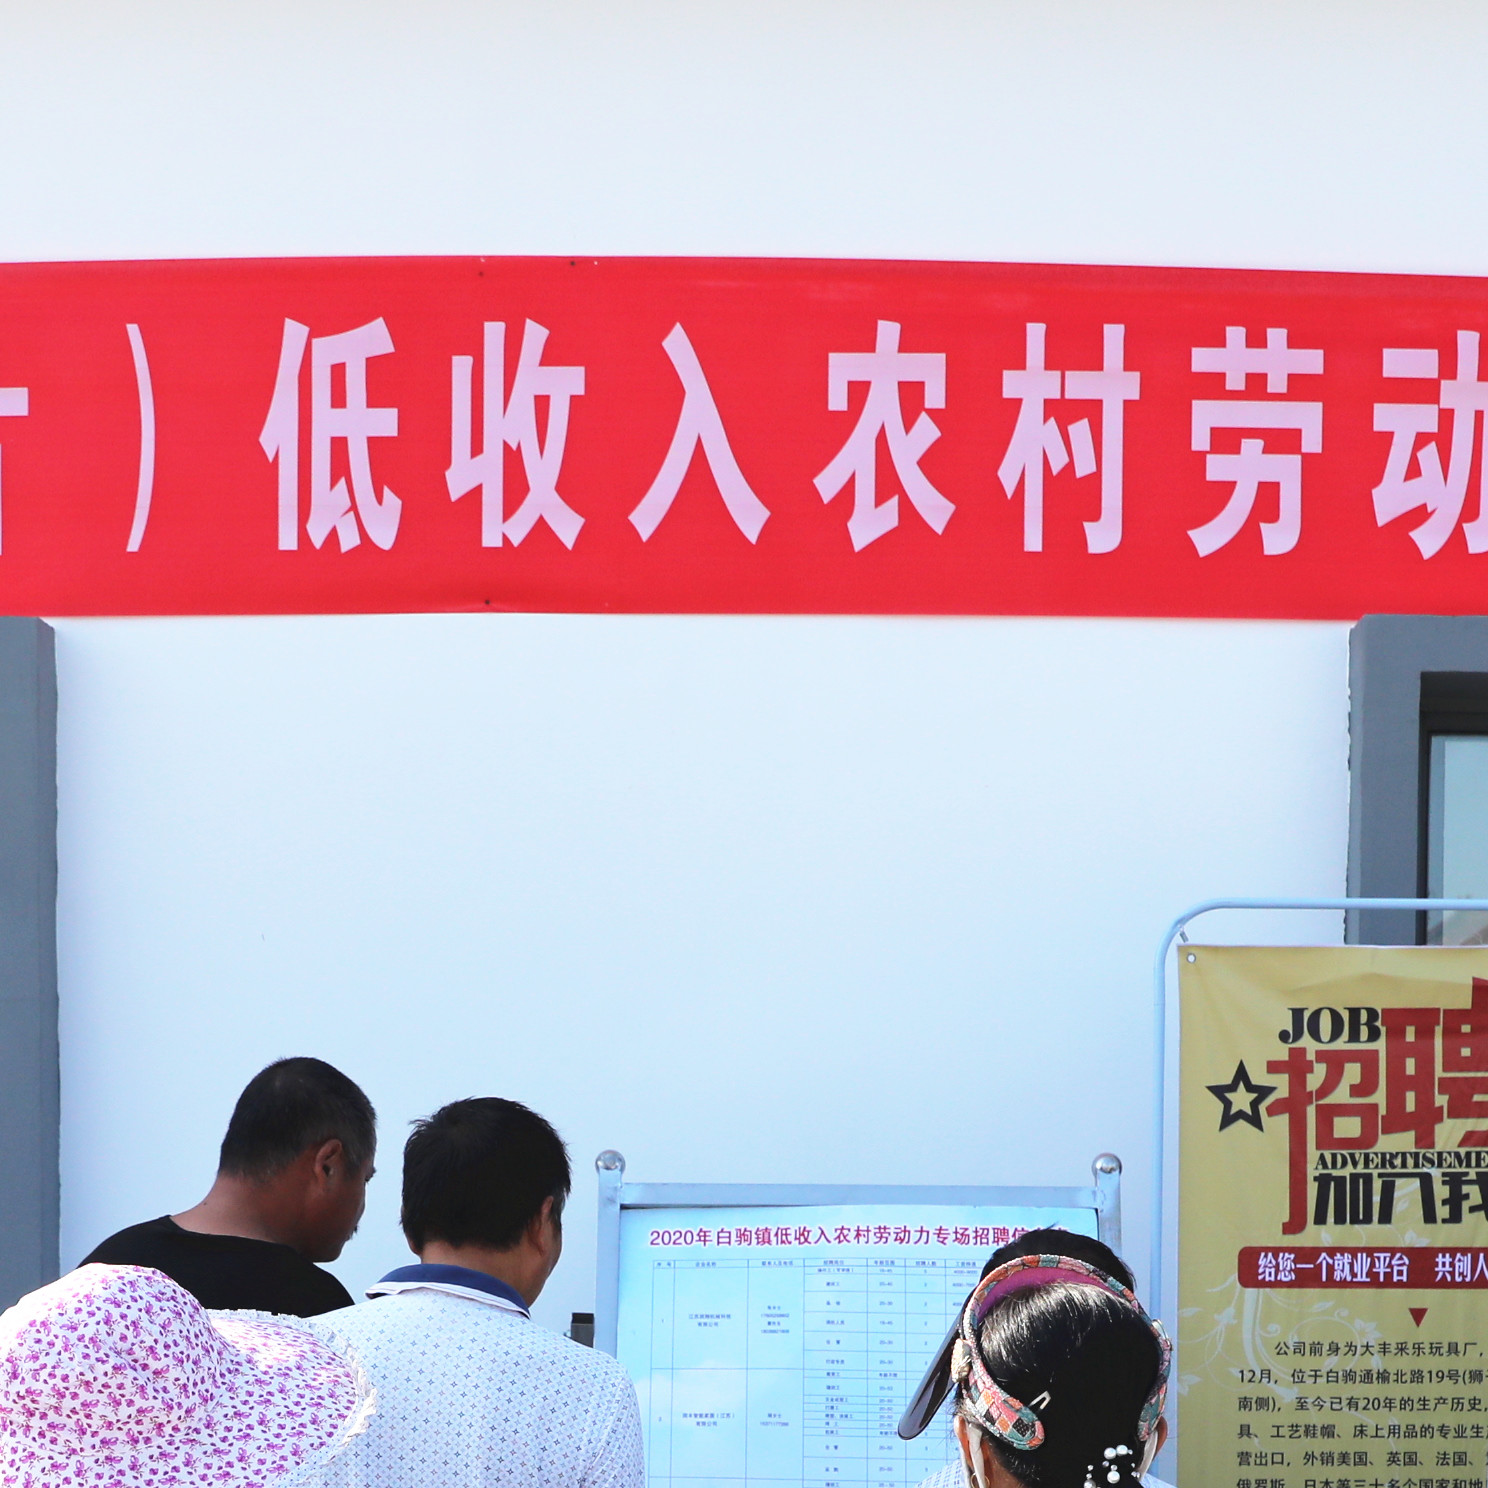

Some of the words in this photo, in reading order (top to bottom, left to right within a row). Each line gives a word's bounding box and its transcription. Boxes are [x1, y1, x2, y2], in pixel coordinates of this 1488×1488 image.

[1278, 1007, 1381, 1044] JOB
[1258, 1252, 1409, 1282] 给您一个就业平台
[1237, 1451, 1488, 1467] 营出口，外销美国、英国、法国、
